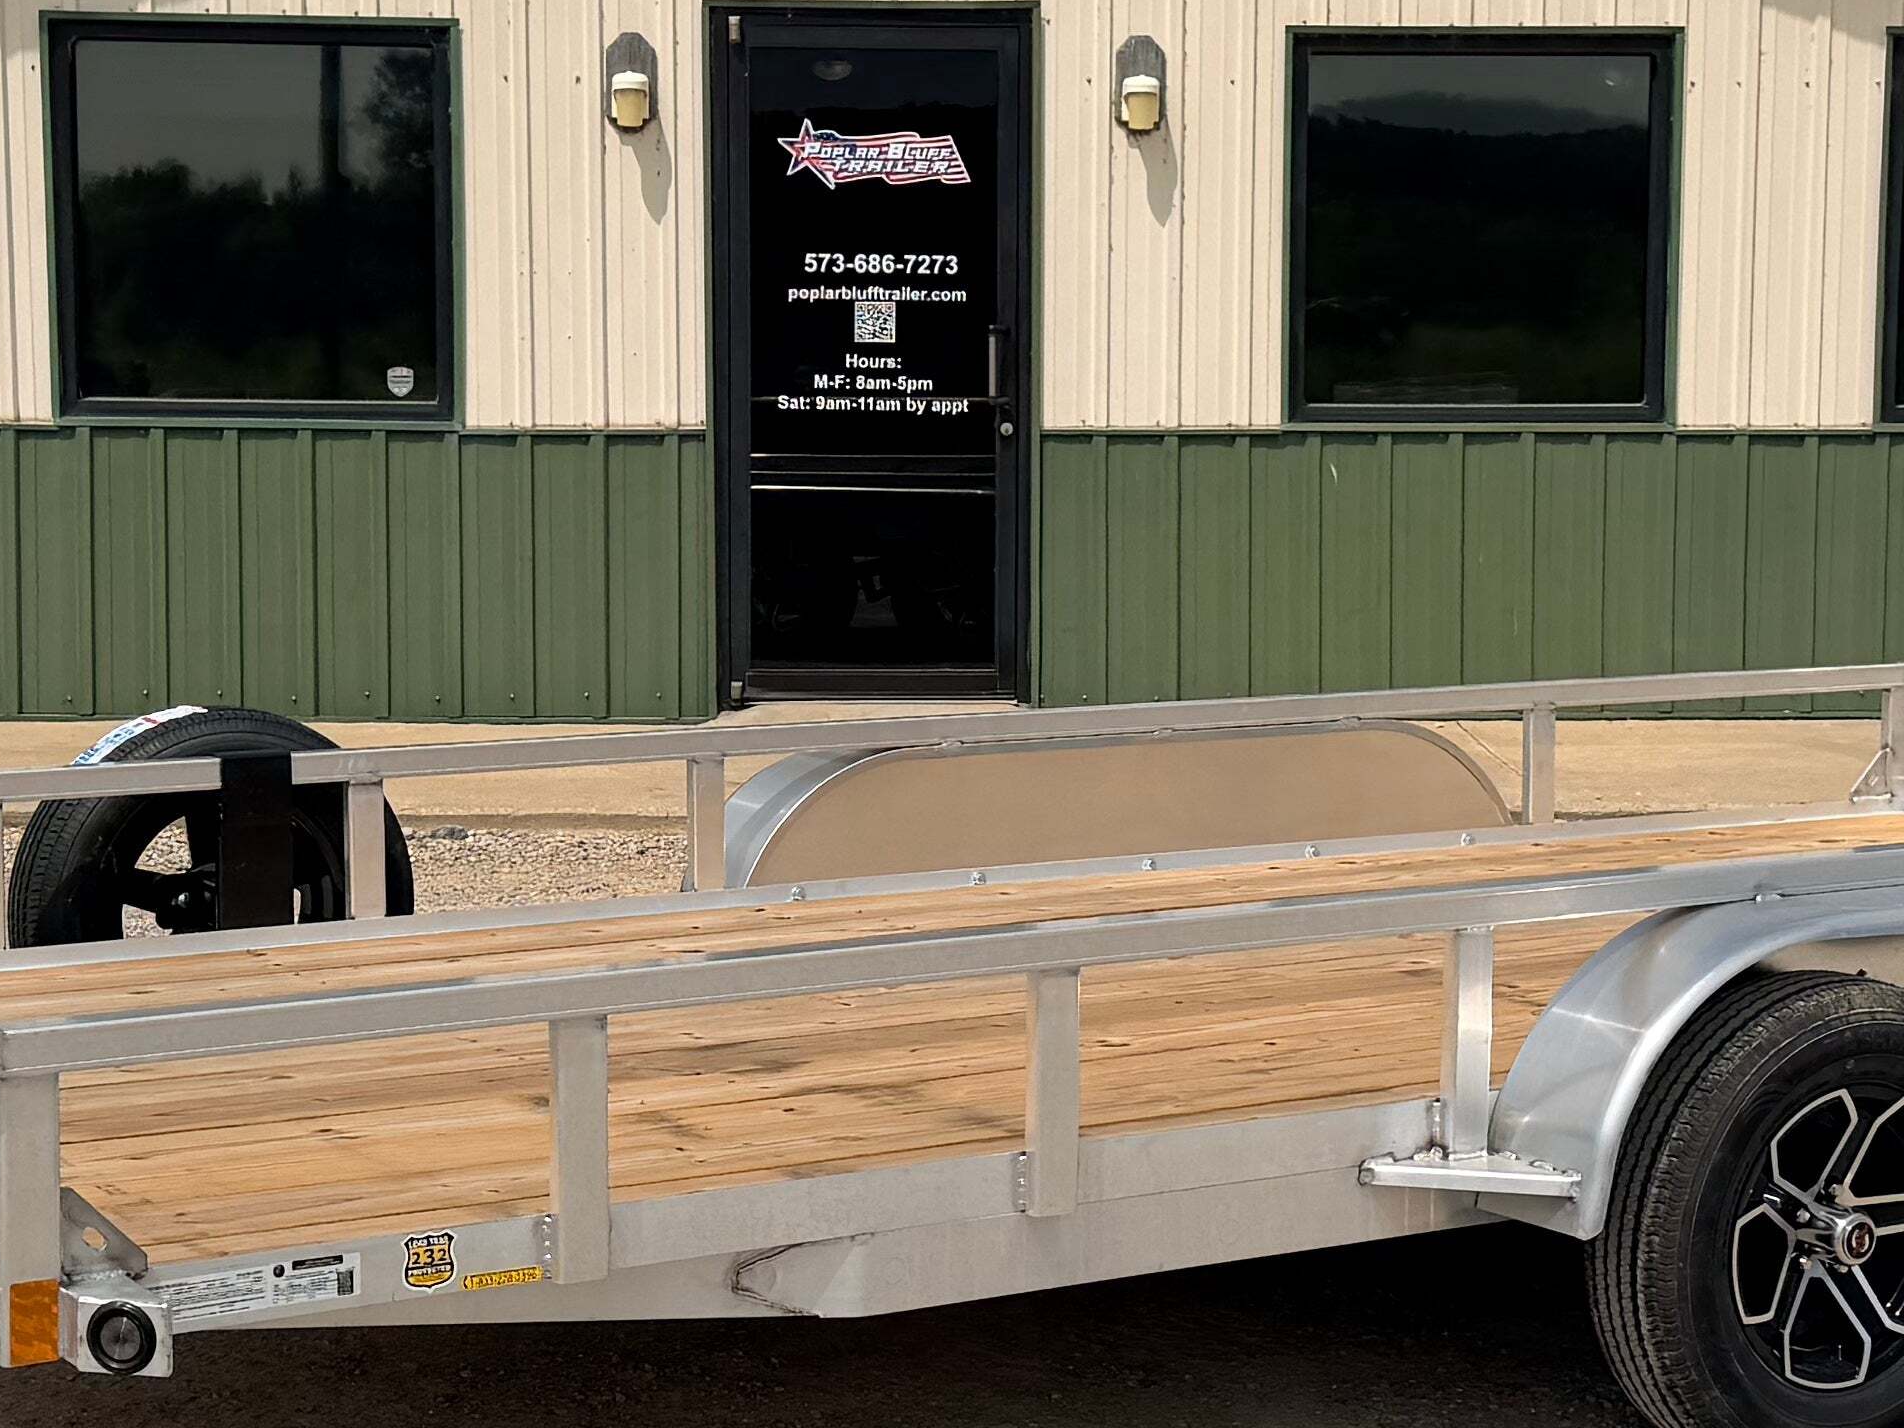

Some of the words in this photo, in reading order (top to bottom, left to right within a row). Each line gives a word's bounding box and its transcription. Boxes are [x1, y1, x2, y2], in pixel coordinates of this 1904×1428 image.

[804, 252, 959, 275] 573-686-7273
[787, 285, 967, 303] poplarblufftrailer.com
[845, 353, 902, 369] Hours:
[813, 373, 851, 390] M-F:
[855, 375, 934, 394] 8am-5pm
[777, 394, 811, 410] Sat:
[815, 395, 901, 411] 9am-11am
[906, 397, 927, 415] by
[931, 398, 969, 415] appt
[411, 1248, 448, 1265] 232
